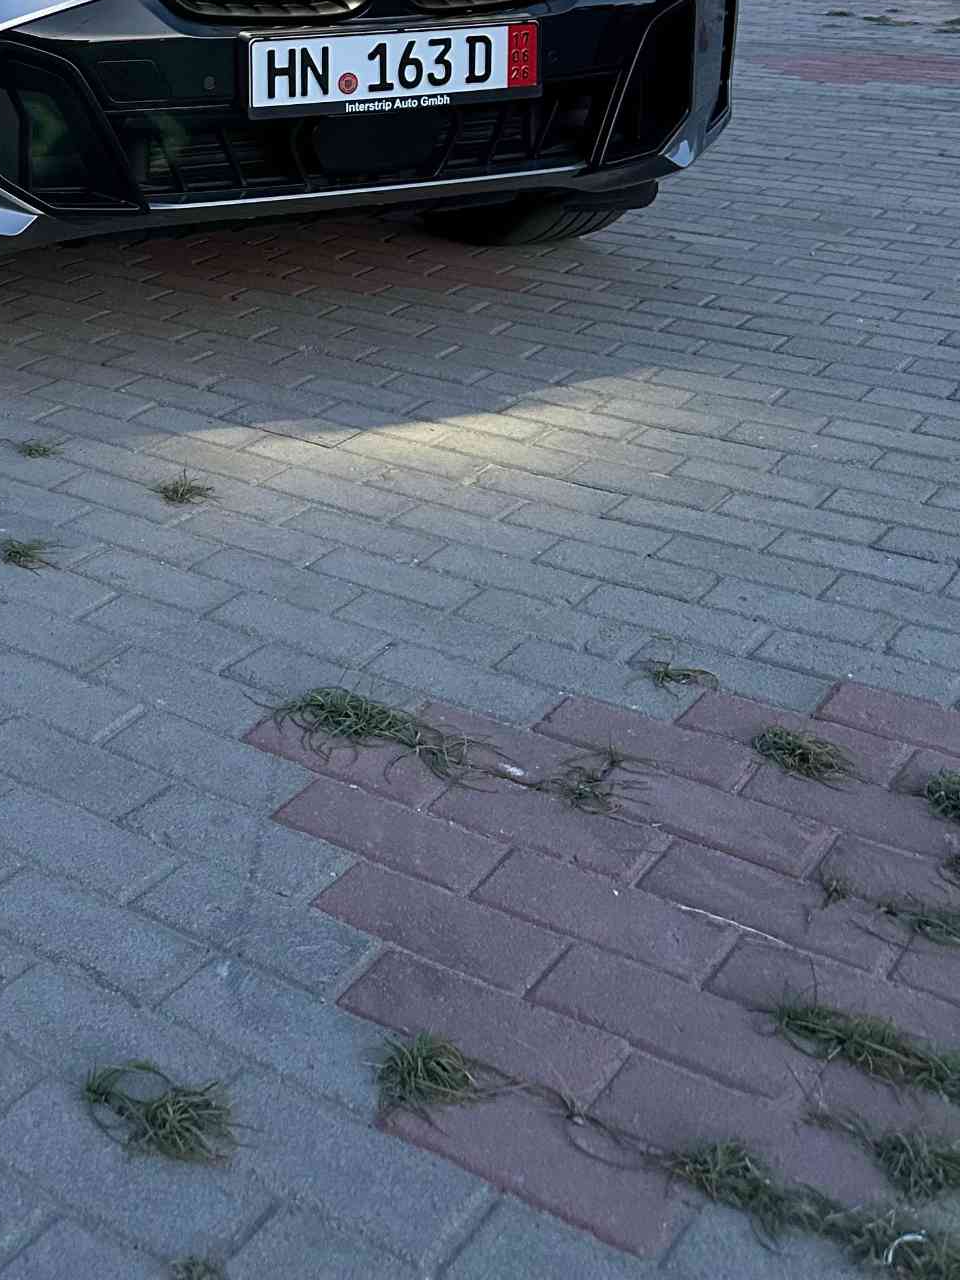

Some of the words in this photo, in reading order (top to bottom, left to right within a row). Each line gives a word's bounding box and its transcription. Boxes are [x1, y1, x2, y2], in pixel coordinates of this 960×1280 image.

[512, 30, 530, 48] 17
[267, 46, 329, 99] HN
[367, 37, 452, 92] 163
[465, 35, 493, 84] D
[345, 100, 392, 113] Interstrip
[393, 98, 418, 109] Auto
[420, 95, 450, 107] Gmbh
